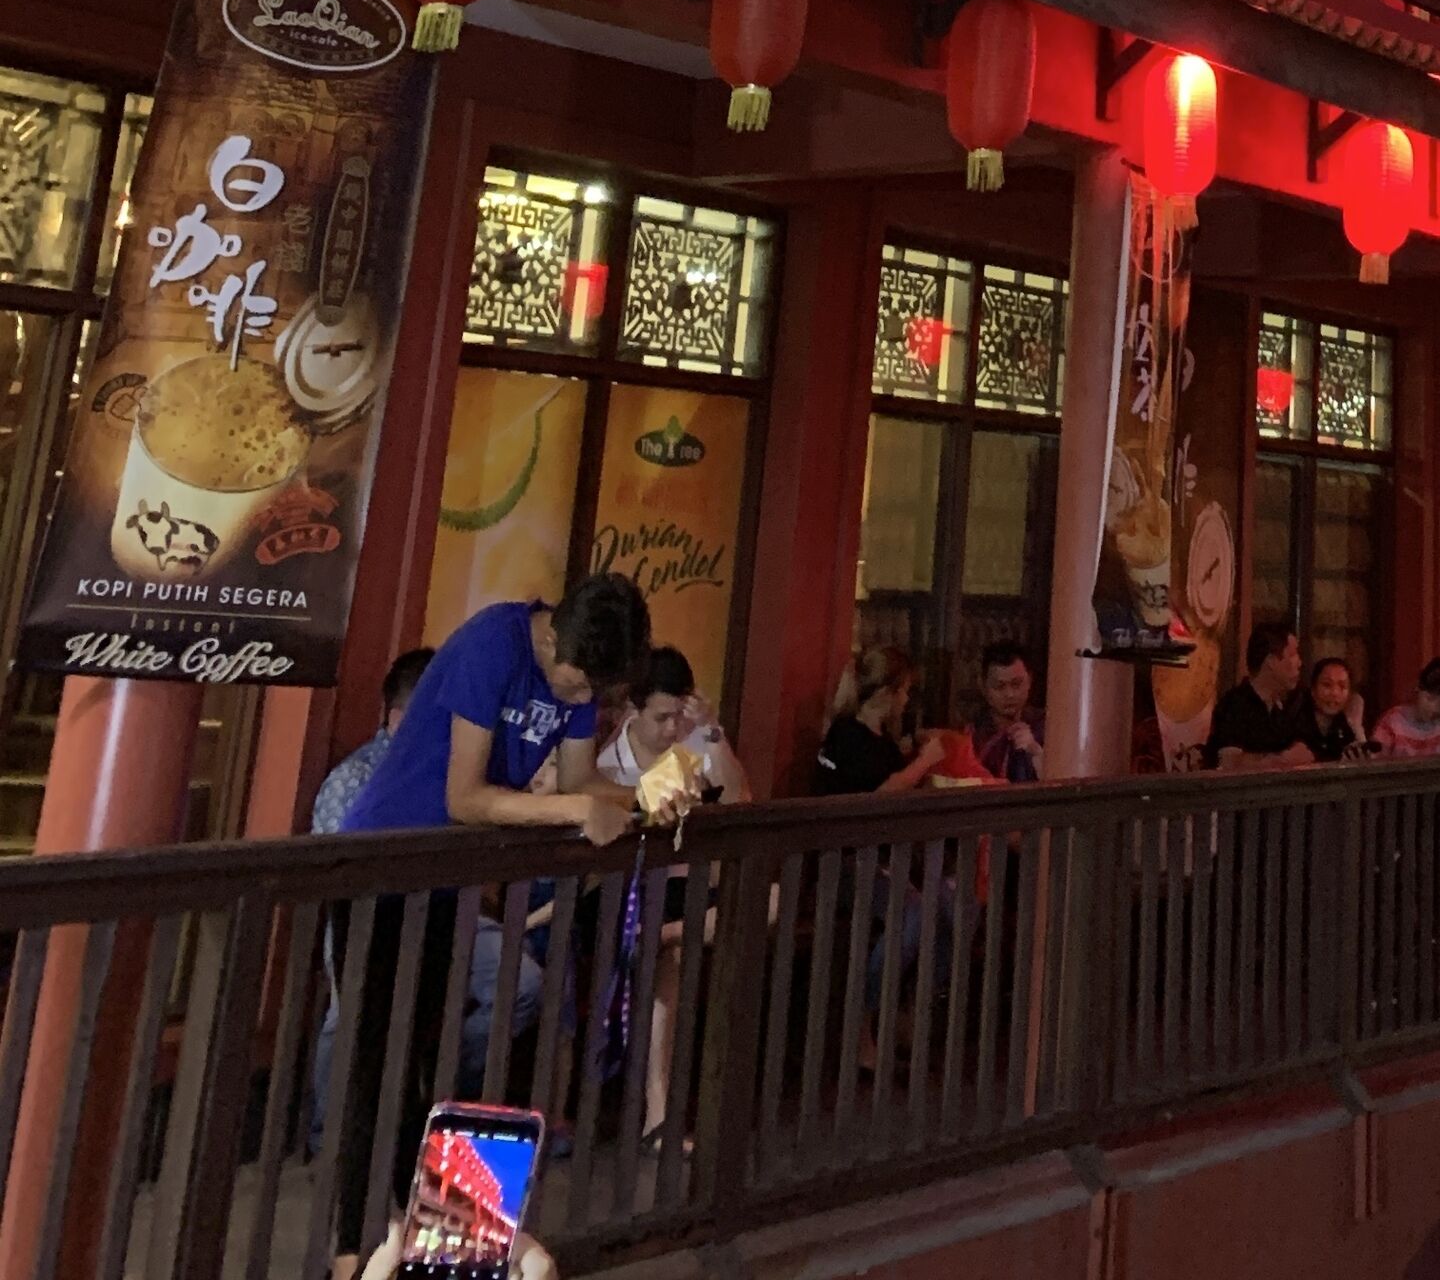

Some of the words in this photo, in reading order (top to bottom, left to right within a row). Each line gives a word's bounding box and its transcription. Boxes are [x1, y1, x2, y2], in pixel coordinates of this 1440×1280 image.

[148, 135, 286, 372] 白咖啡
[77, 578, 134, 599] KOPI
[143, 582, 209, 603] PUTIH
[218, 587, 308, 609] SEGERA
[65, 631, 174, 672] White
[179, 637, 295, 684] Coffee
